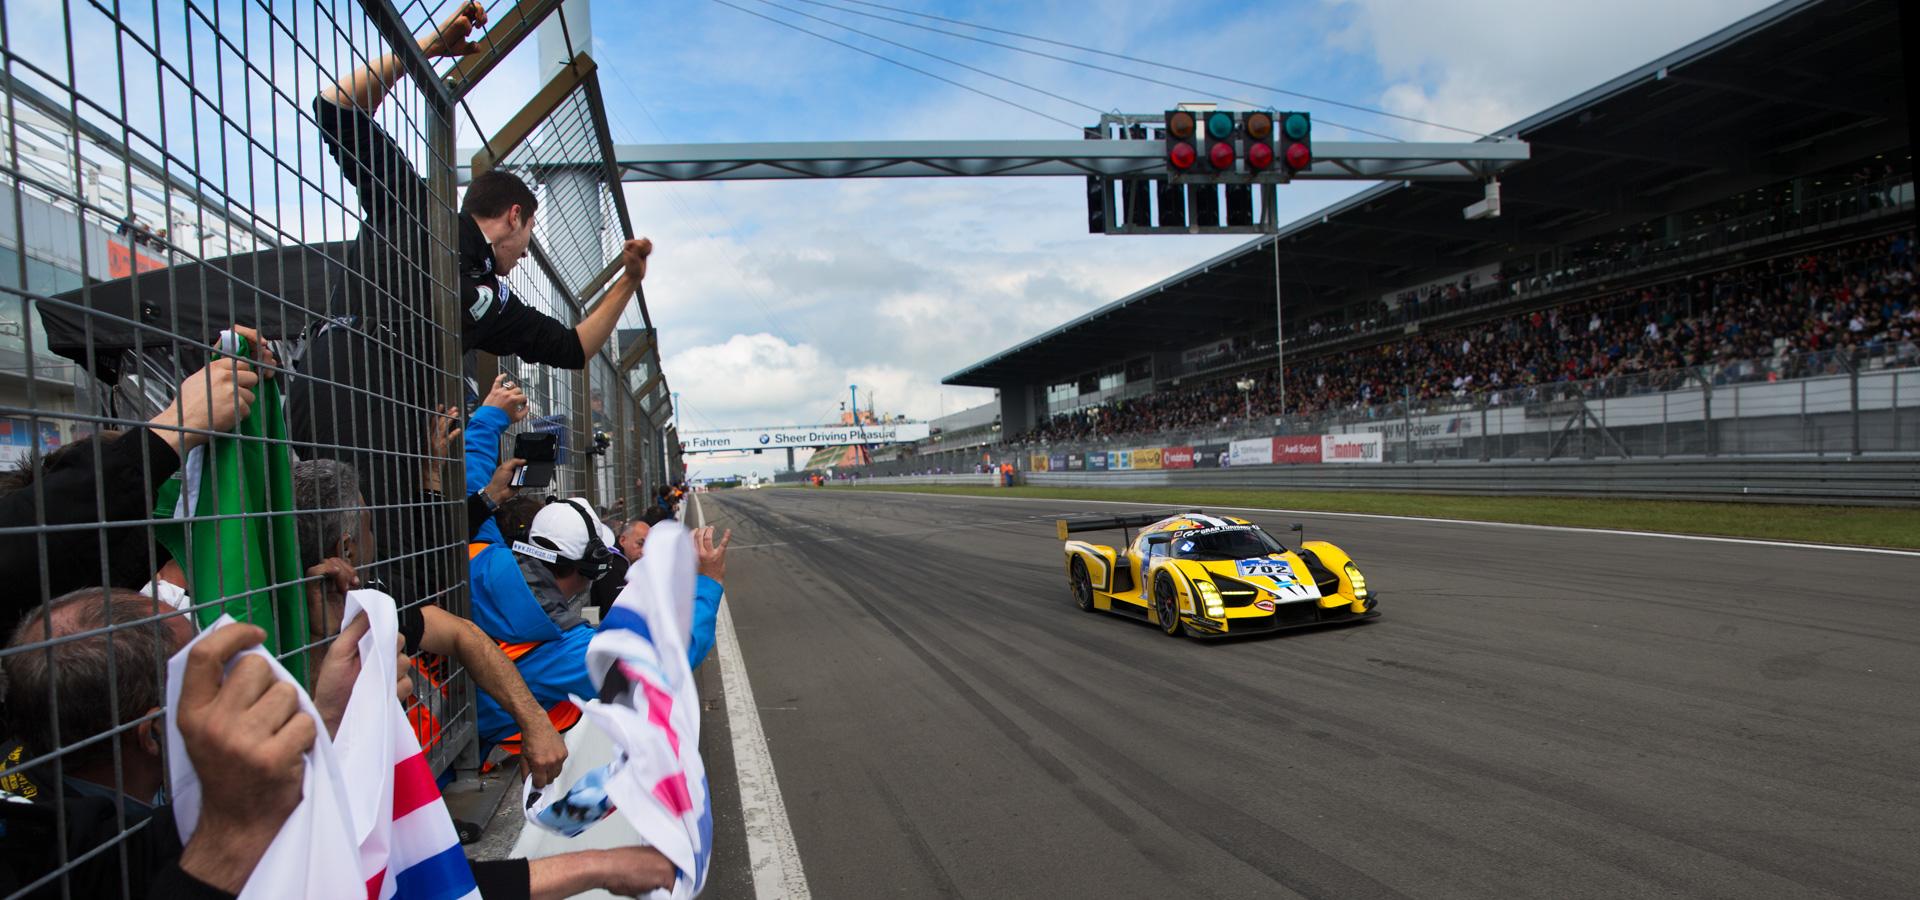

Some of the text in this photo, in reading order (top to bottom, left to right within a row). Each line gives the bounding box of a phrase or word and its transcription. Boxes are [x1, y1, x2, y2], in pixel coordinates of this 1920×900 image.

[693, 437, 730, 447] Fahren
[775, 429, 895, 443] Sheer Driving Pleasure
[1285, 444, 1298, 454] Audi
[1299, 443, 1317, 455] Sport
[1335, 442, 1377, 459] motorsport
[1245, 566, 1289, 574] 702
